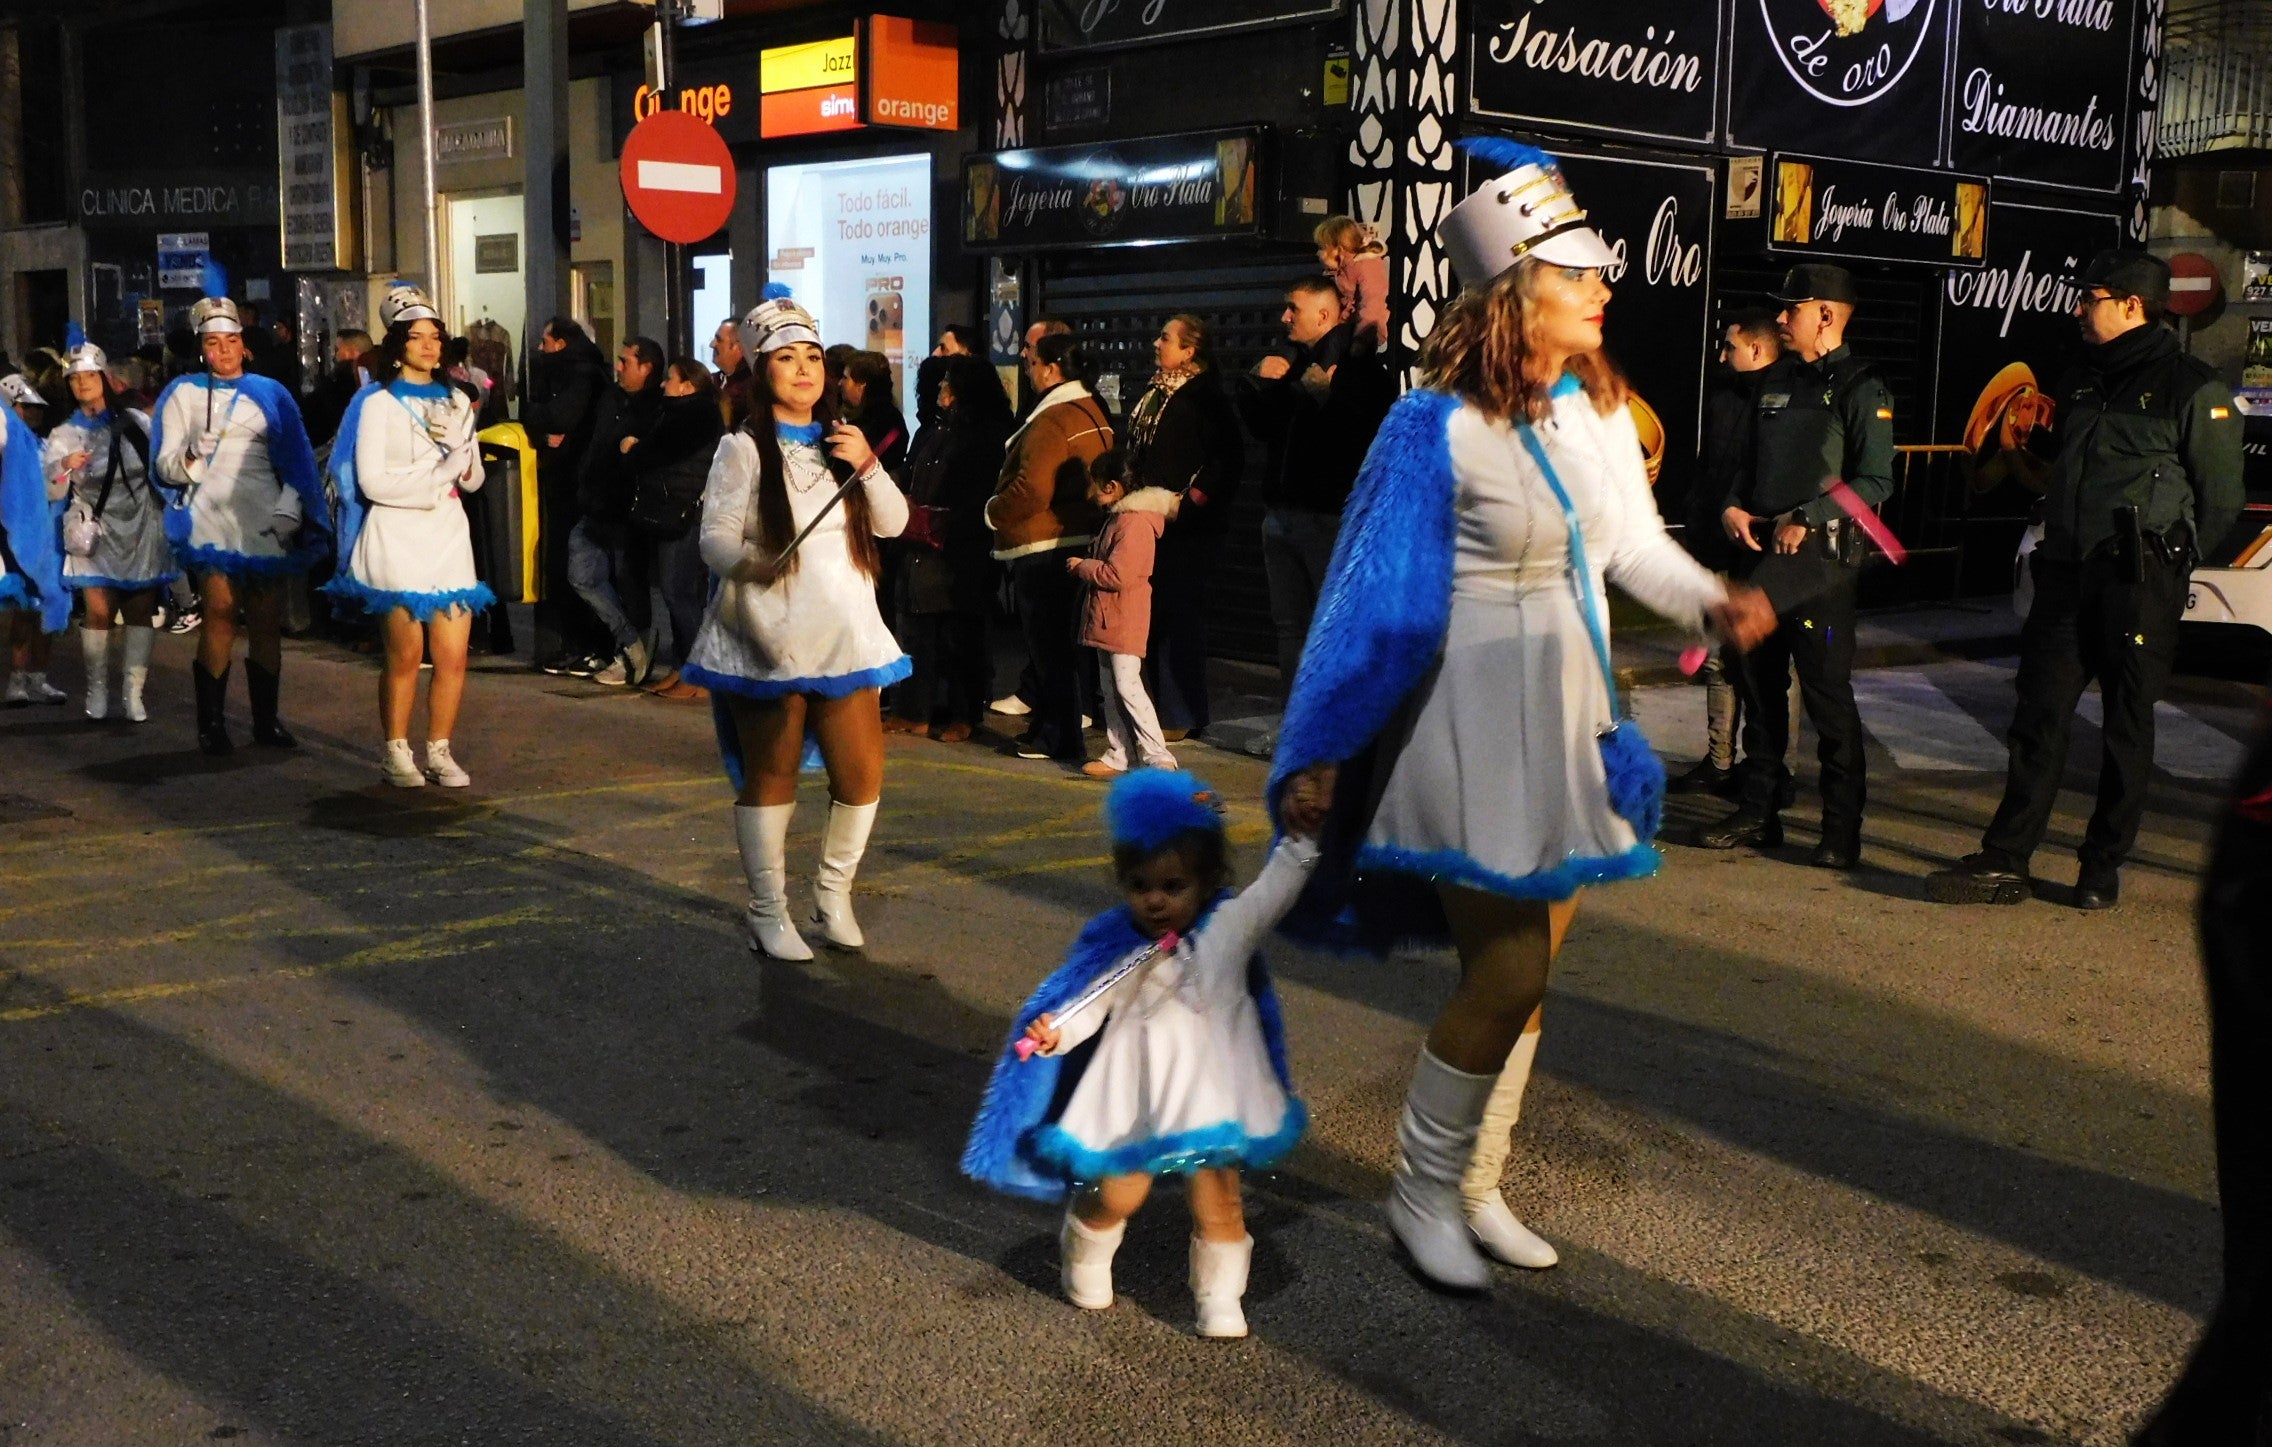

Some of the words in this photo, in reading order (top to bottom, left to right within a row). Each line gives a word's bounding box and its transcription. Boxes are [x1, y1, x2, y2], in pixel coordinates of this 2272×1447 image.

[822, 53, 854, 72] Jazz
[1489, 11, 1702, 93] Tasación
[1790, 29, 1832, 77] de
[1843, 43, 1891, 92] oro
[634, 84, 731, 126] Ornge
[877, 98, 949, 125] orange
[1962, 67, 2116, 150] Diamantes
[81, 188, 156, 215] CLINICA
[164, 186, 239, 213] MEDICA
[838, 192, 872, 213] Todo
[877, 187, 911, 210] fácil.
[1003, 174, 1073, 227] Joyería
[1131, 167, 1160, 209] Oro
[1162, 162, 1212, 207] Plata
[838, 218, 873, 240] Todo
[877, 218, 929, 240] orange
[1813, 184, 1874, 243] Joyería
[1882, 191, 1907, 232] Oro
[1909, 194, 1951, 236] Plata
[1646, 195, 1702, 287] Oro
[866, 276, 904, 292] PRO
[1948, 250, 2083, 338] Empeñ
[2247, 286, 2267, 296] 927
[2251, 320, 2272, 333] VE
